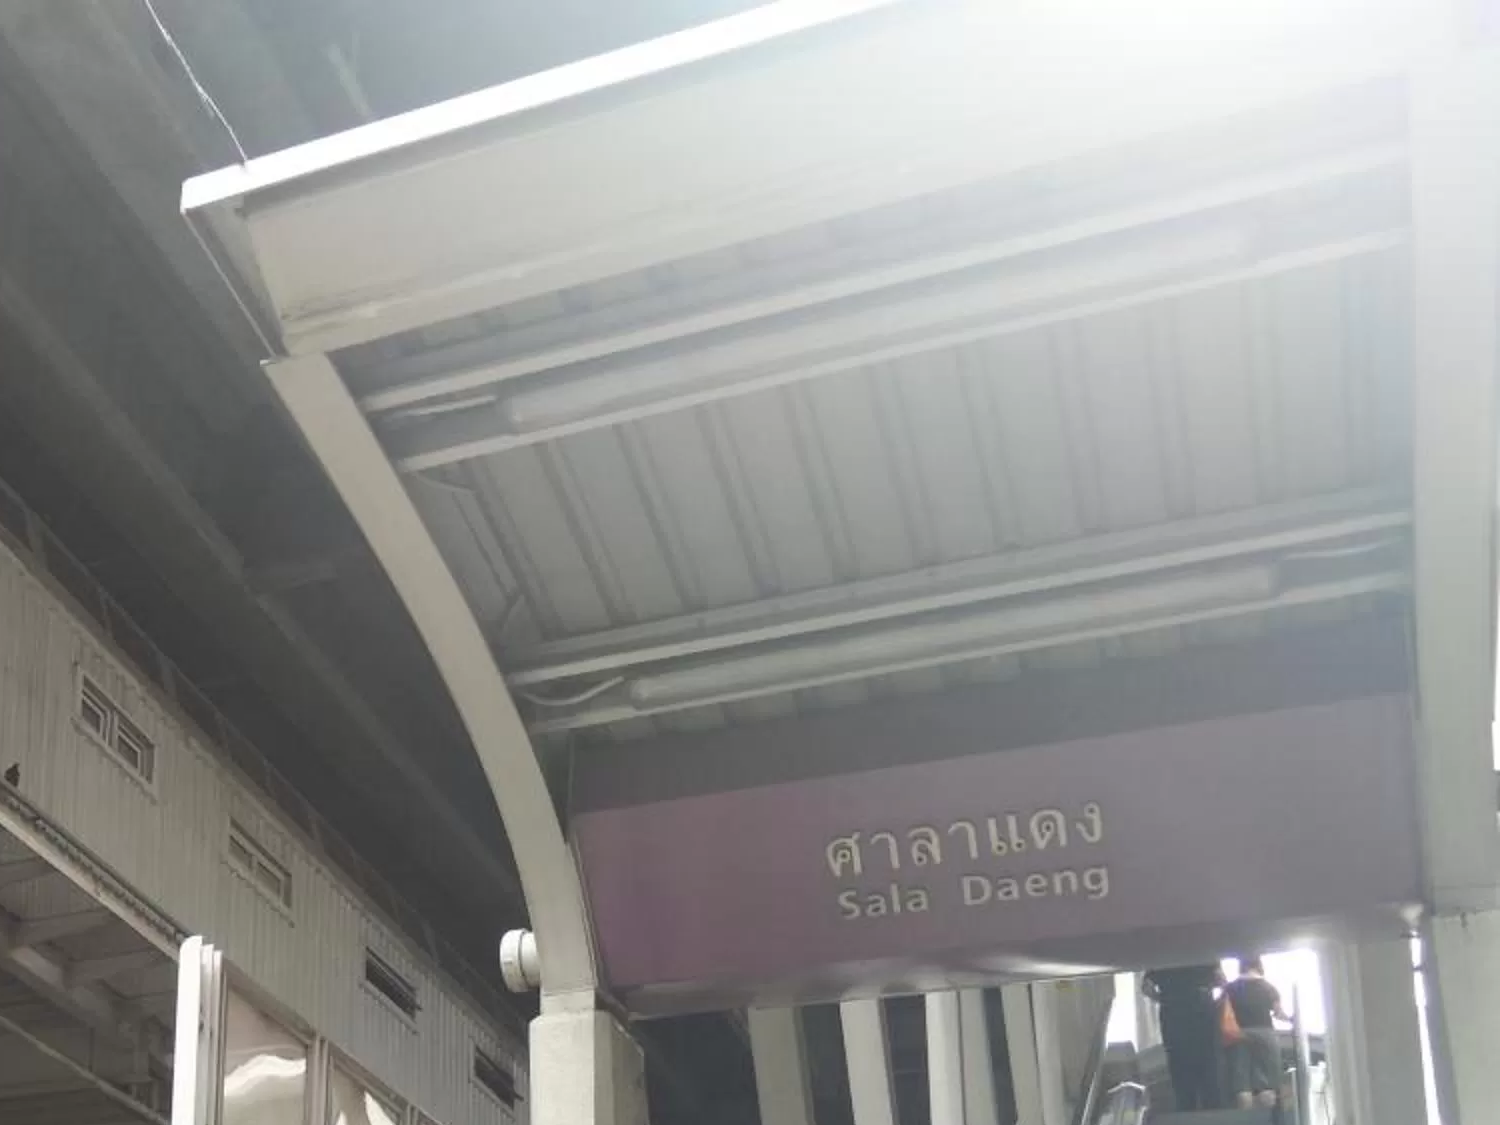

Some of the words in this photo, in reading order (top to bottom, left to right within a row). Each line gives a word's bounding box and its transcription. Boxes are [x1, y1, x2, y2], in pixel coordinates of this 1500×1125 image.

[825, 802, 1103, 878] ศาลาแดง
[837, 884, 930, 920] Sala
[961, 865, 1110, 906] Daeng
